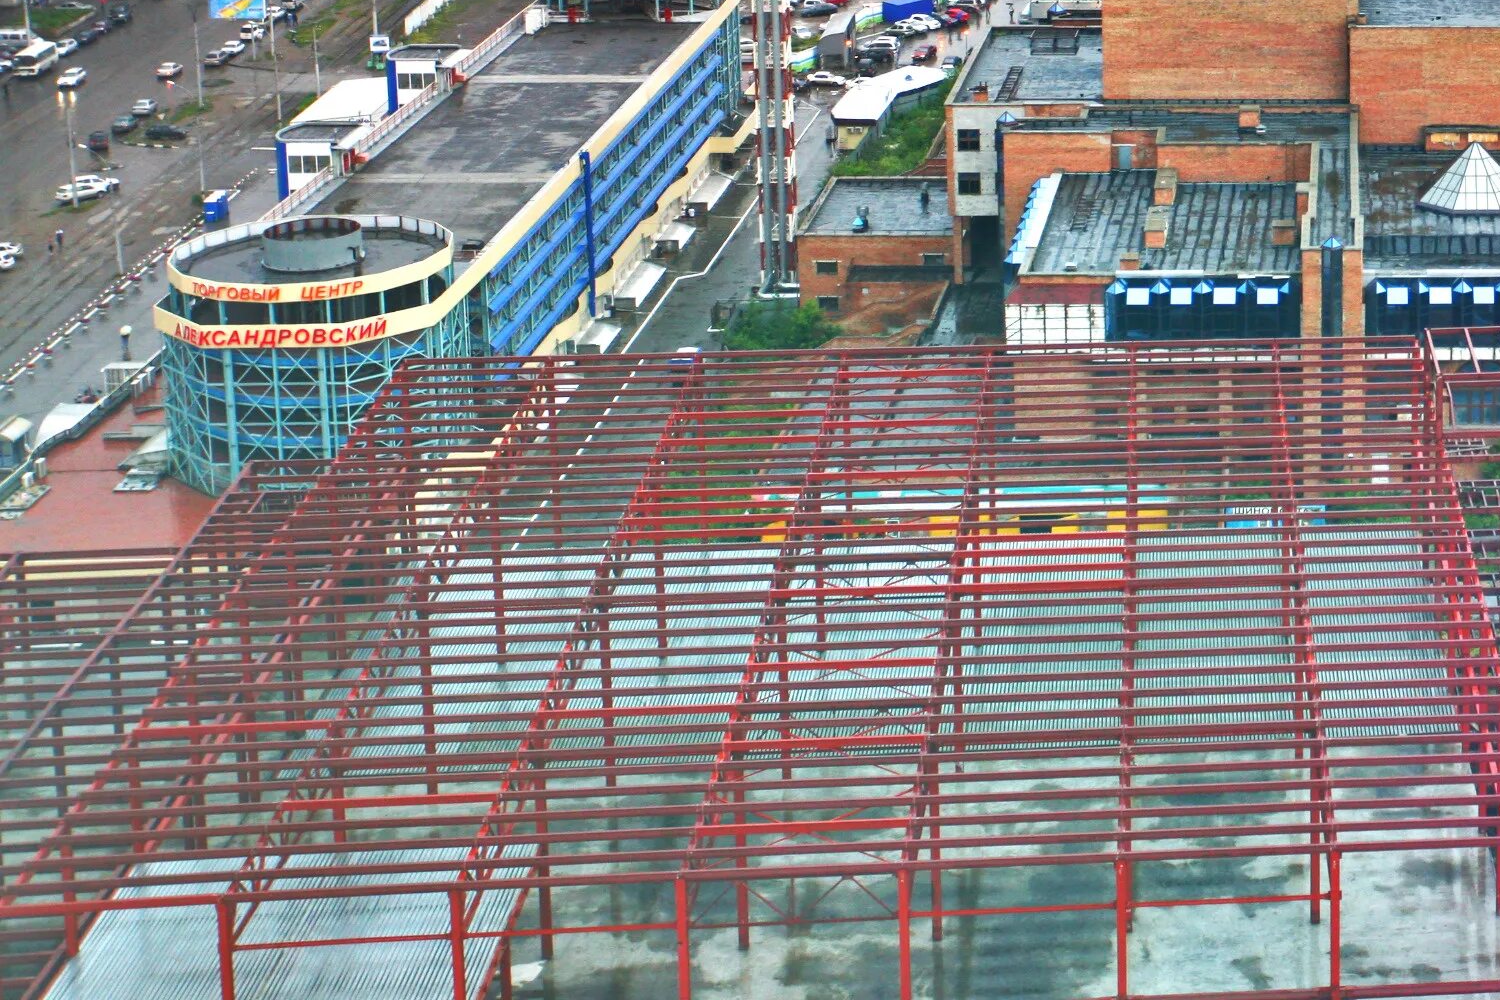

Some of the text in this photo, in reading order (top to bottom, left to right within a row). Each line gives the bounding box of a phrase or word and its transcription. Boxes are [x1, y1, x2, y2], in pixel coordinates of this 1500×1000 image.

[191, 280, 364, 301] ТОРГОВЫЙ ЦЕНТР
[174, 316, 388, 349] АЛЕКСАНДРОВСКИЙ
